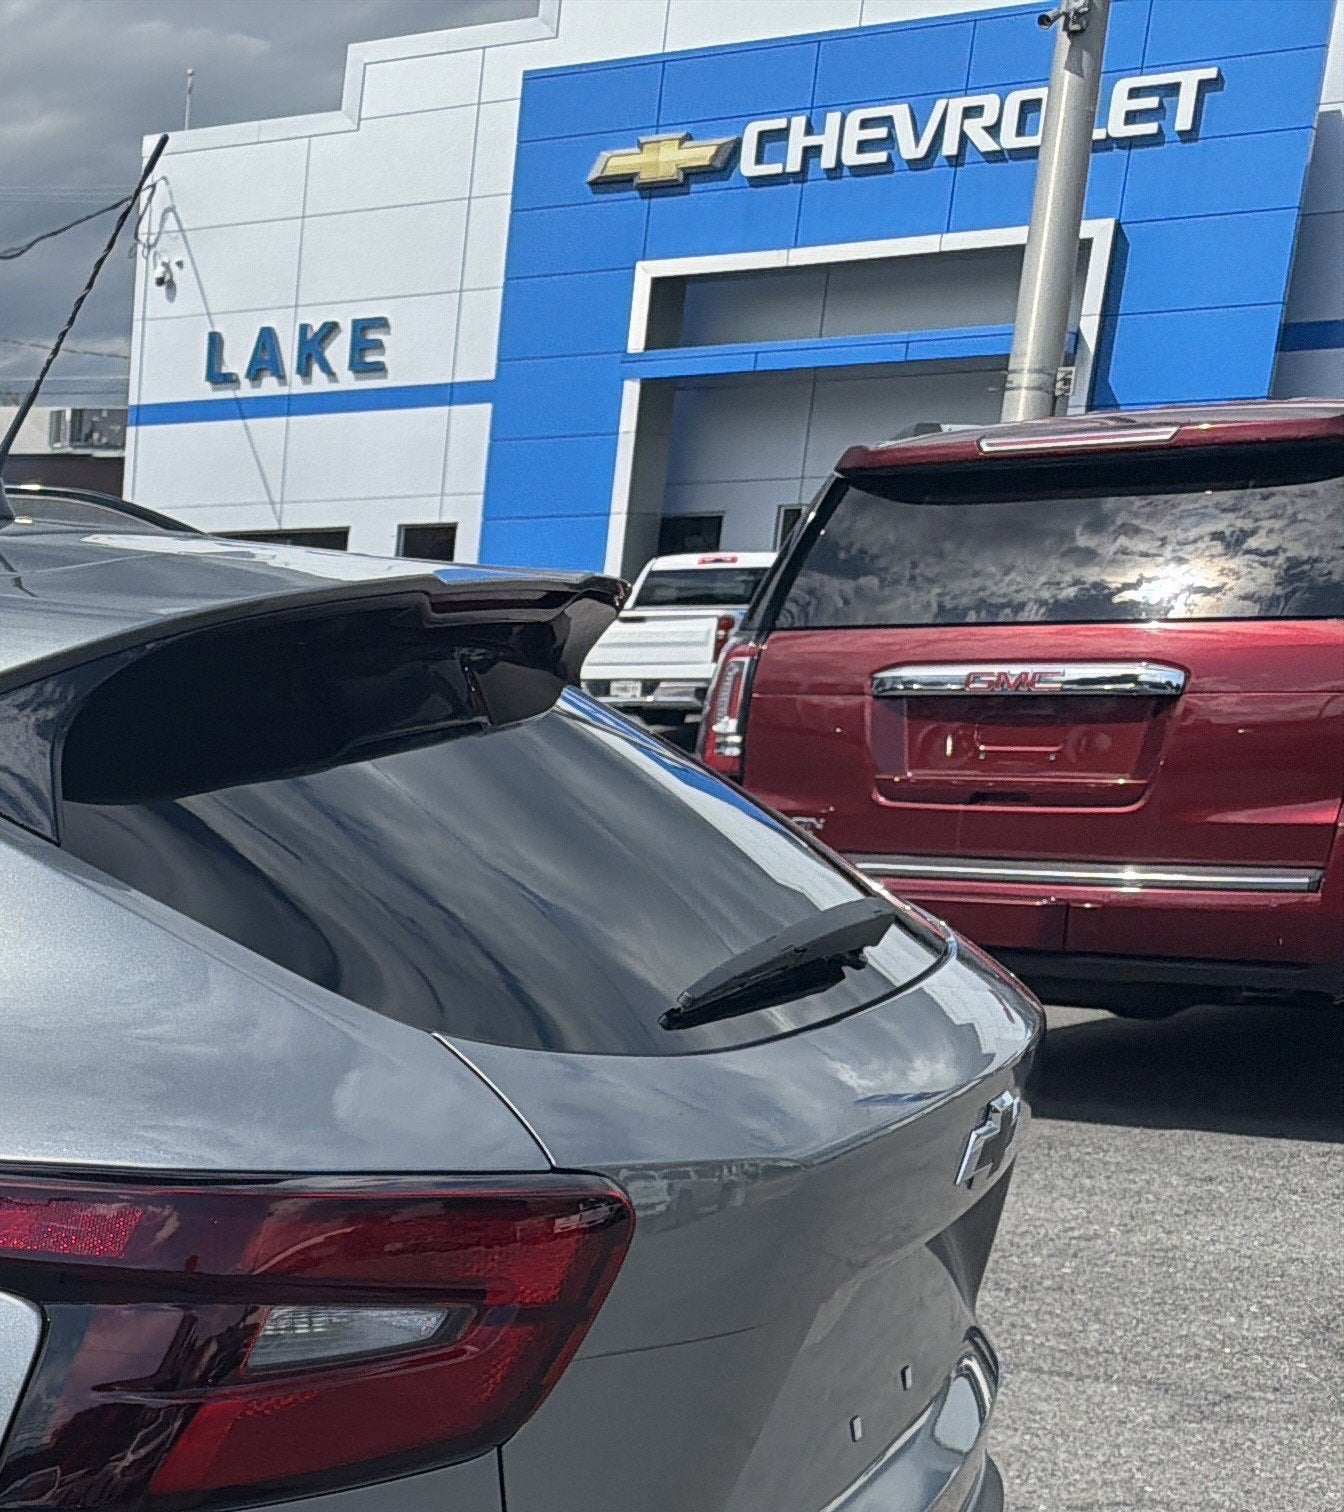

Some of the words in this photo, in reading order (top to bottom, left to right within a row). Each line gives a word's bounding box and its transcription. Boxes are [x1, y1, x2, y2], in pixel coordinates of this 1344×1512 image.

[740, 67, 1219, 178] CHEVROET
[204, 316, 391, 387] LAKE
[964, 670, 1064, 693] GMC
